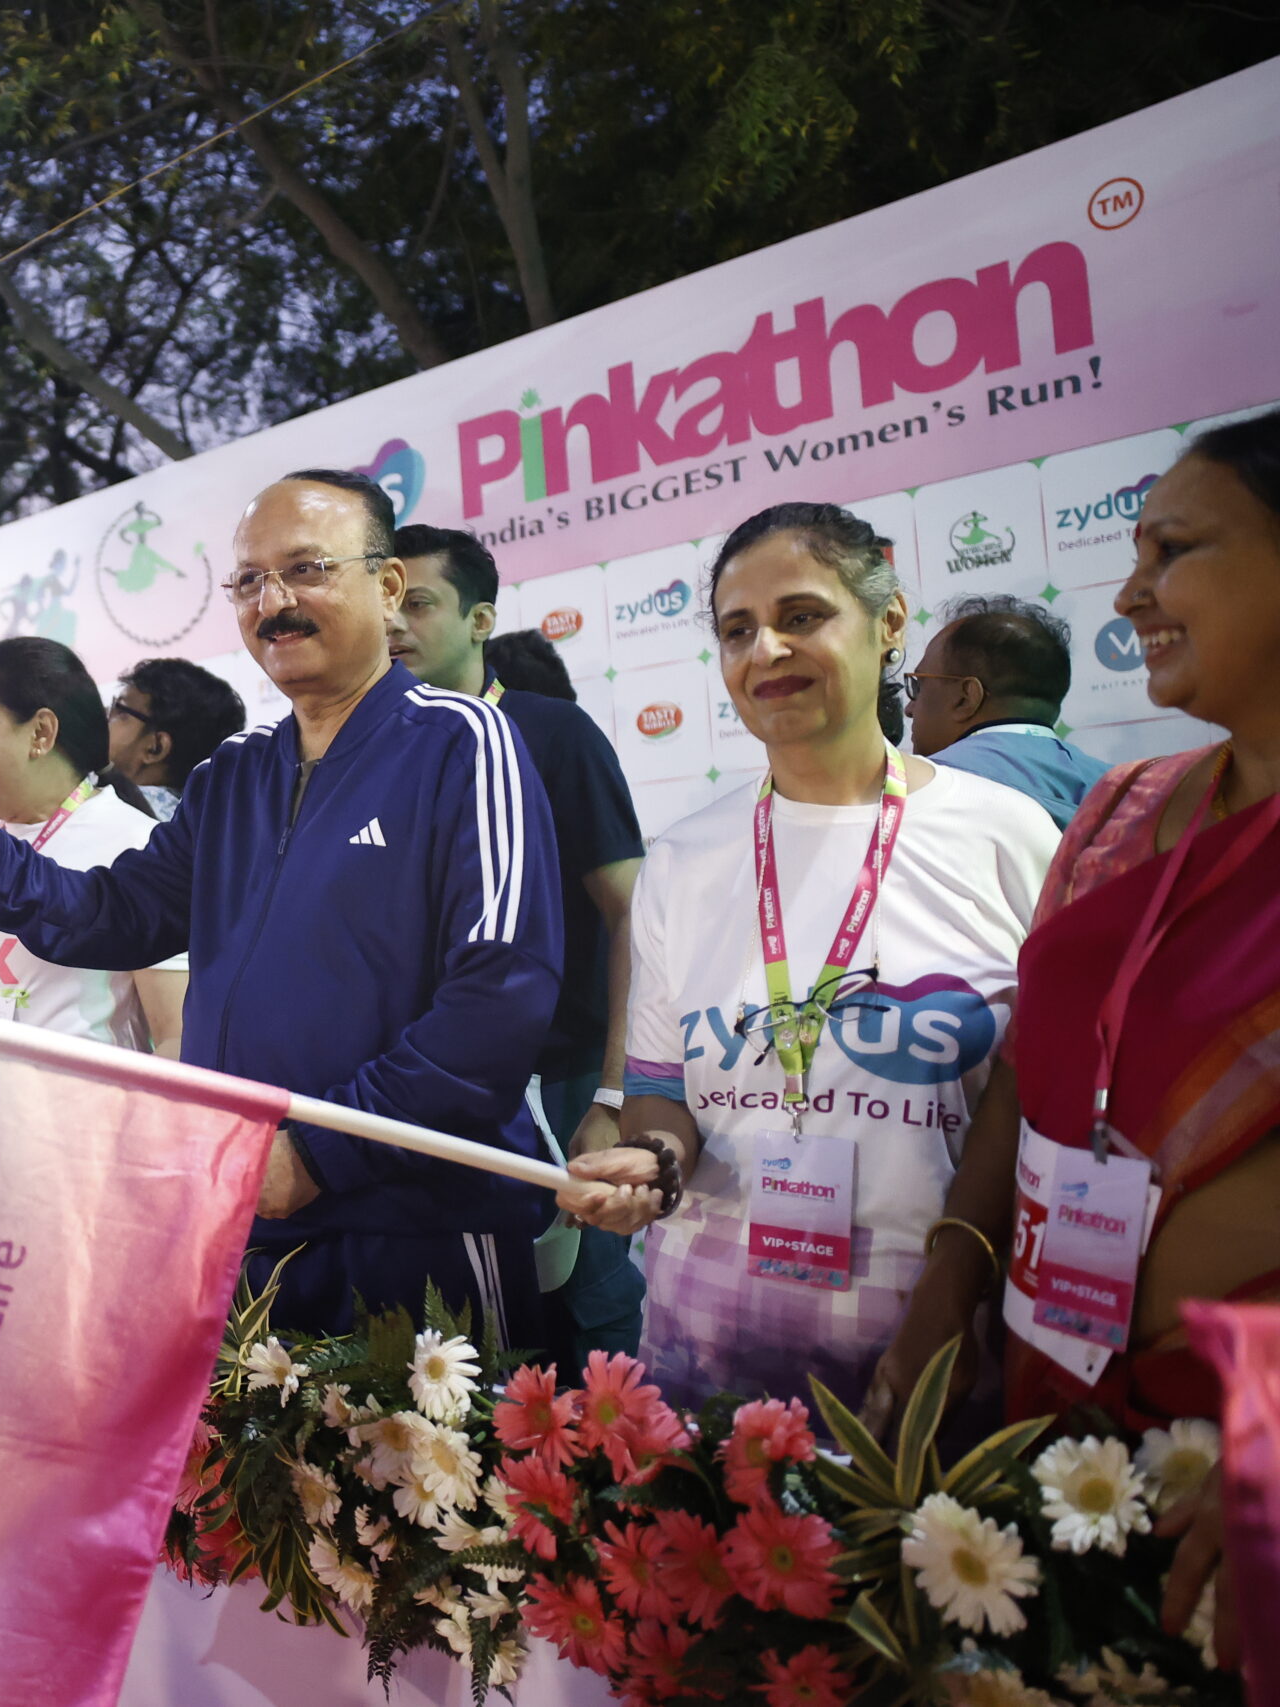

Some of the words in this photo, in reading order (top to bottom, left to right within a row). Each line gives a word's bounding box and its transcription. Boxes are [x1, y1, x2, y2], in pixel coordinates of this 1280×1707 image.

[1097, 191, 1133, 216] TM
[458, 241, 1094, 519] Pinkathon
[585, 456, 748, 522] BIGGEST
[764, 402, 966, 473] Women's
[988, 356, 1104, 418] Run!
[1056, 491, 1147, 531] zydu
[1058, 531, 1122, 551] Dedicated
[615, 590, 683, 623] zydus
[642, 708, 676, 722] TASTY
[847, 1091, 890, 1120] To
[902, 1099, 962, 1133] Life
[762, 1176, 836, 1199] Pinkathon
[762, 1236, 834, 1257] VIP+STAGE
[1050, 1276, 1117, 1306] VIP+STAGE
